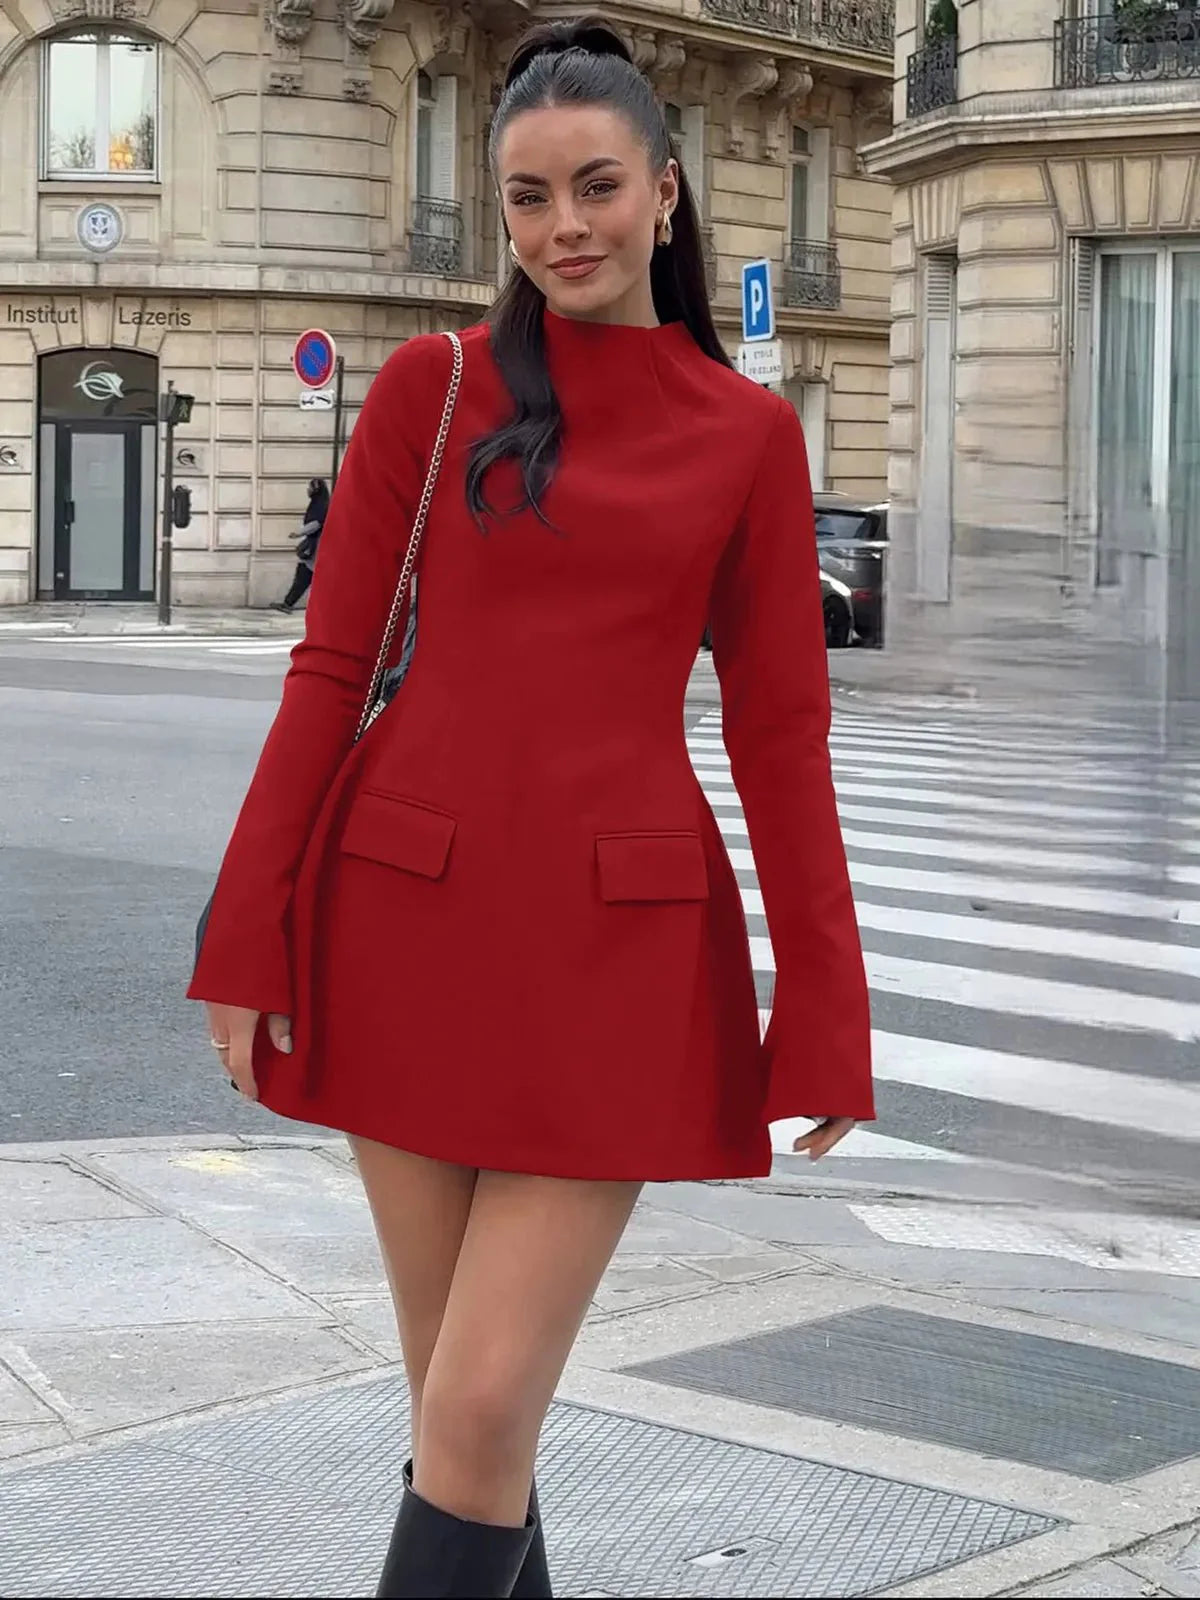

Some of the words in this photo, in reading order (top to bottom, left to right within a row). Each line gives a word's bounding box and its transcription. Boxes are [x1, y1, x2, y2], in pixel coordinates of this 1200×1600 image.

[7, 303, 79, 324] Institut
[119, 306, 192, 326] Lazeris
[750, 279, 763, 327] P
